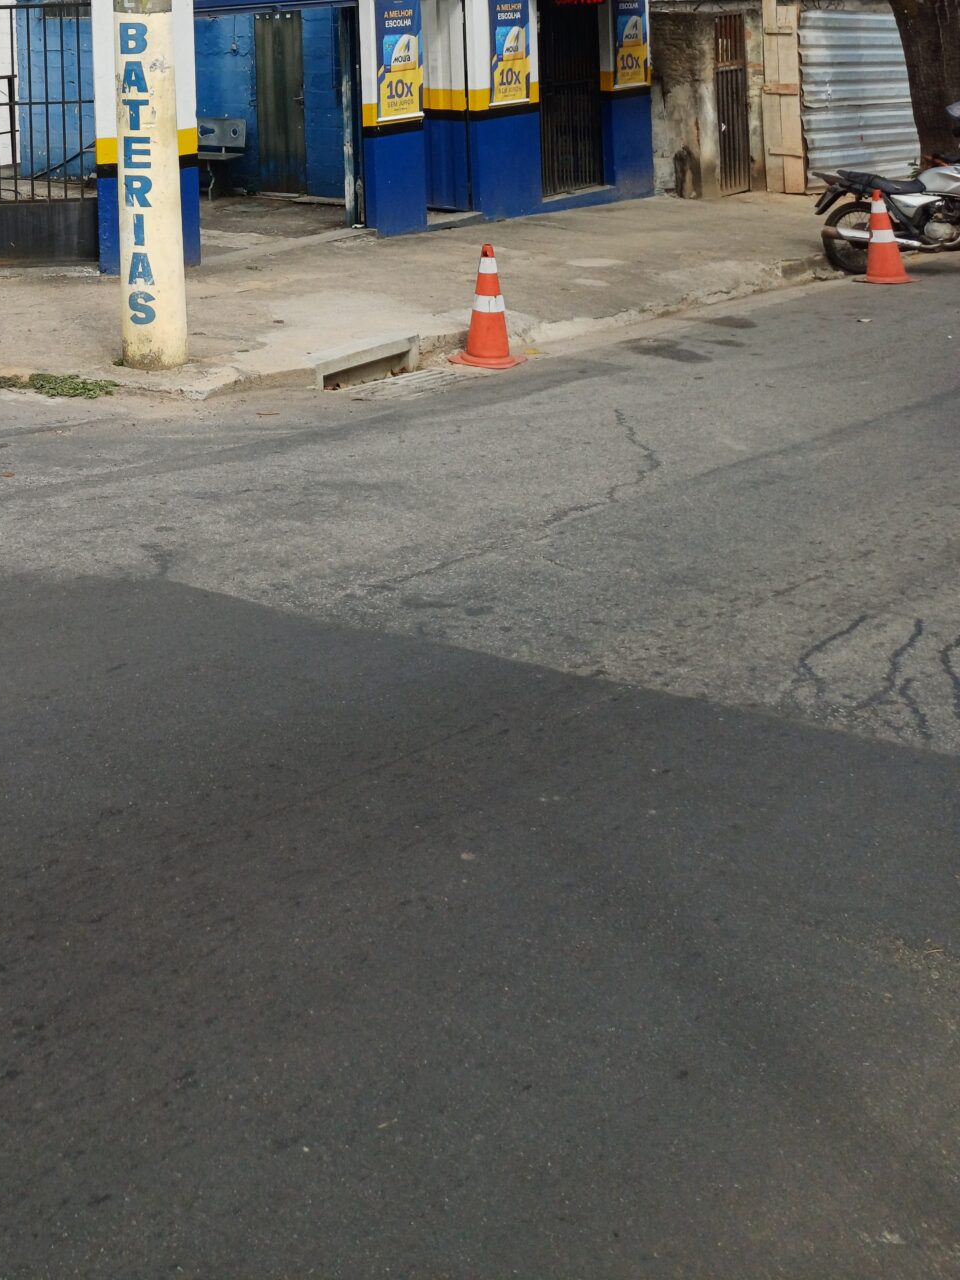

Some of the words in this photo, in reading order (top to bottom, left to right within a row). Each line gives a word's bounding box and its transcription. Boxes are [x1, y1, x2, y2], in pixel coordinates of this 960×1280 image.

[389, 9, 413, 19] MELHOR
[497, 11, 521, 20] ESCOLHA
[385, 19, 412, 28] ESCOLHA
[620, 53, 640, 70] 10x
[499, 67, 521, 86] 10x
[386, 79, 414, 100] 10x
